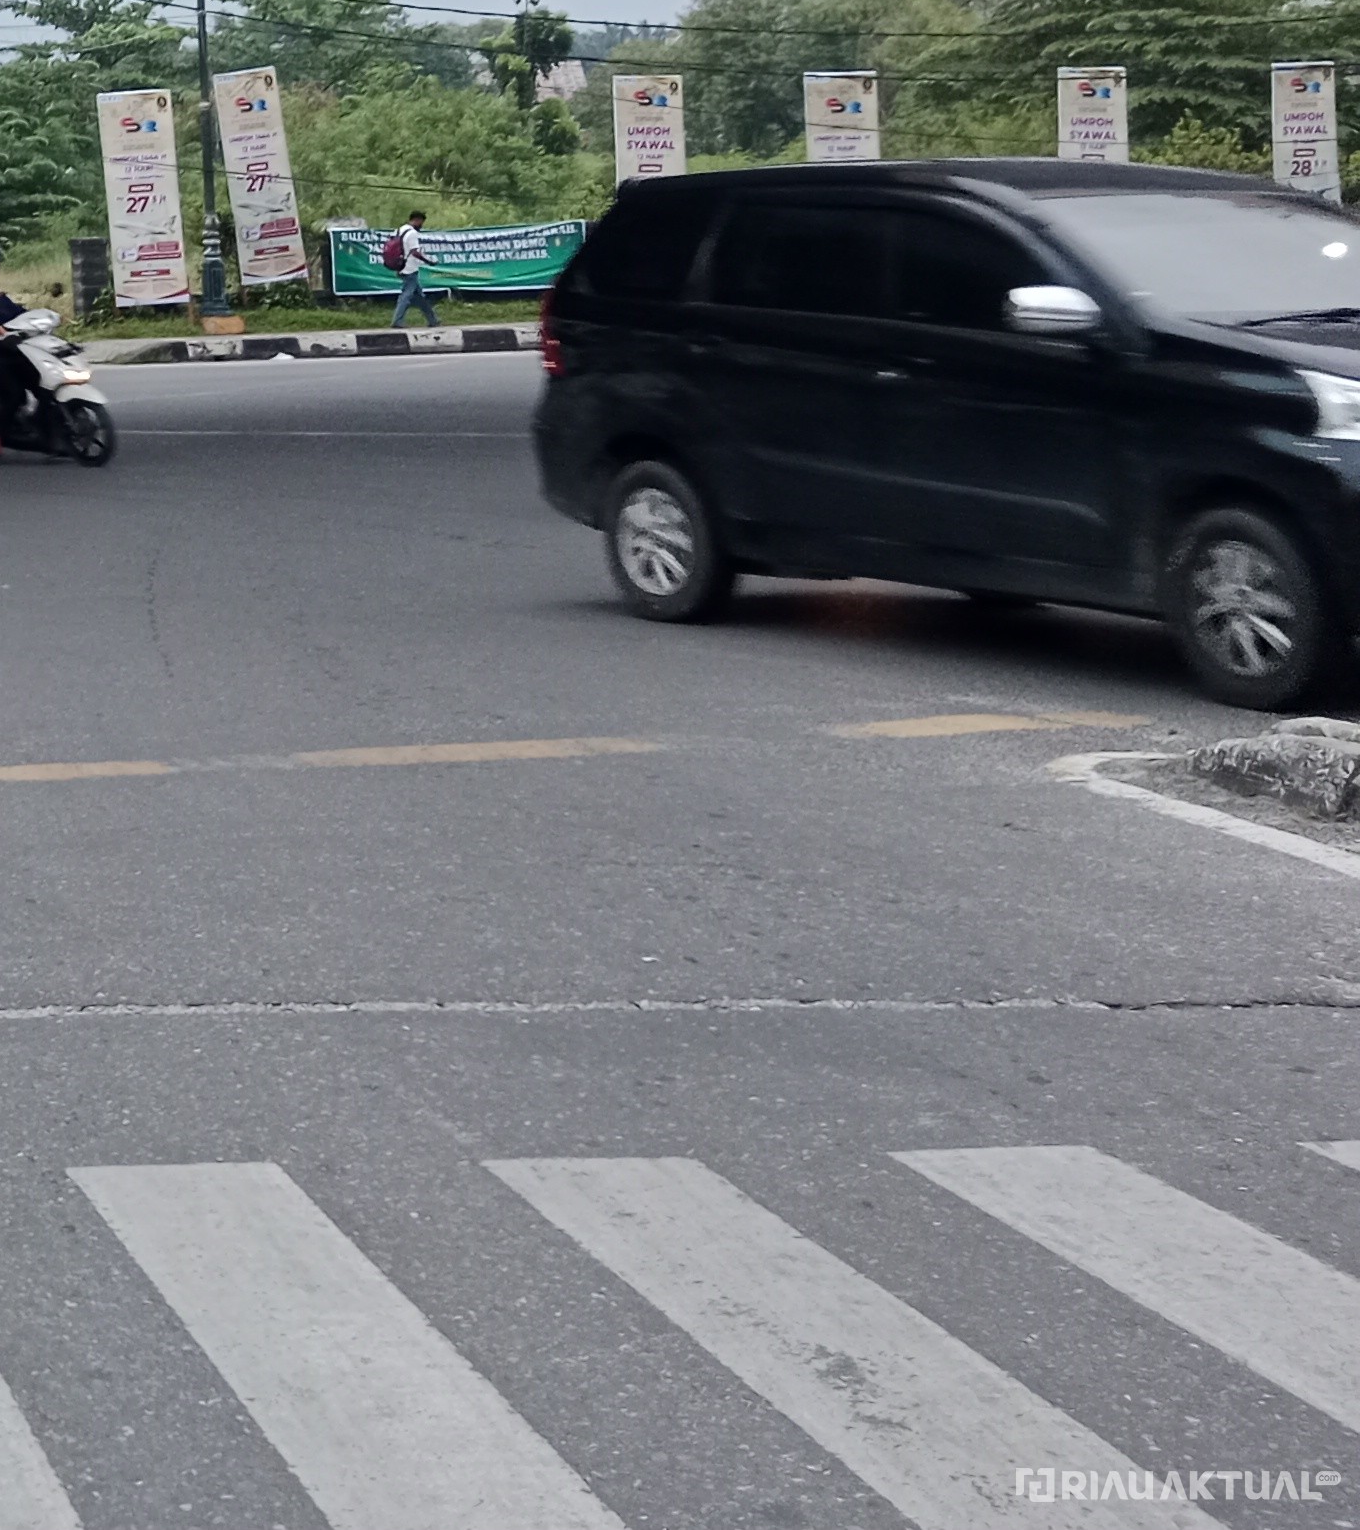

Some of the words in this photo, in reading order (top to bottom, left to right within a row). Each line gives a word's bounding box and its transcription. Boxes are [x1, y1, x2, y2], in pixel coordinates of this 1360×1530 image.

[1070, 116, 1114, 127] UMROH
[1283, 111, 1325, 122] UMROH
[627, 126, 671, 136] UMROH
[1069, 130, 1117, 141] SYAWAL
[1282, 125, 1328, 136] SYAWAL
[626, 140, 675, 150] SYAWAL
[1290, 159, 1312, 176] 28
[246, 175, 266, 193] 27
[126, 196, 150, 214] 27
[468, 250, 496, 263] AKSI
